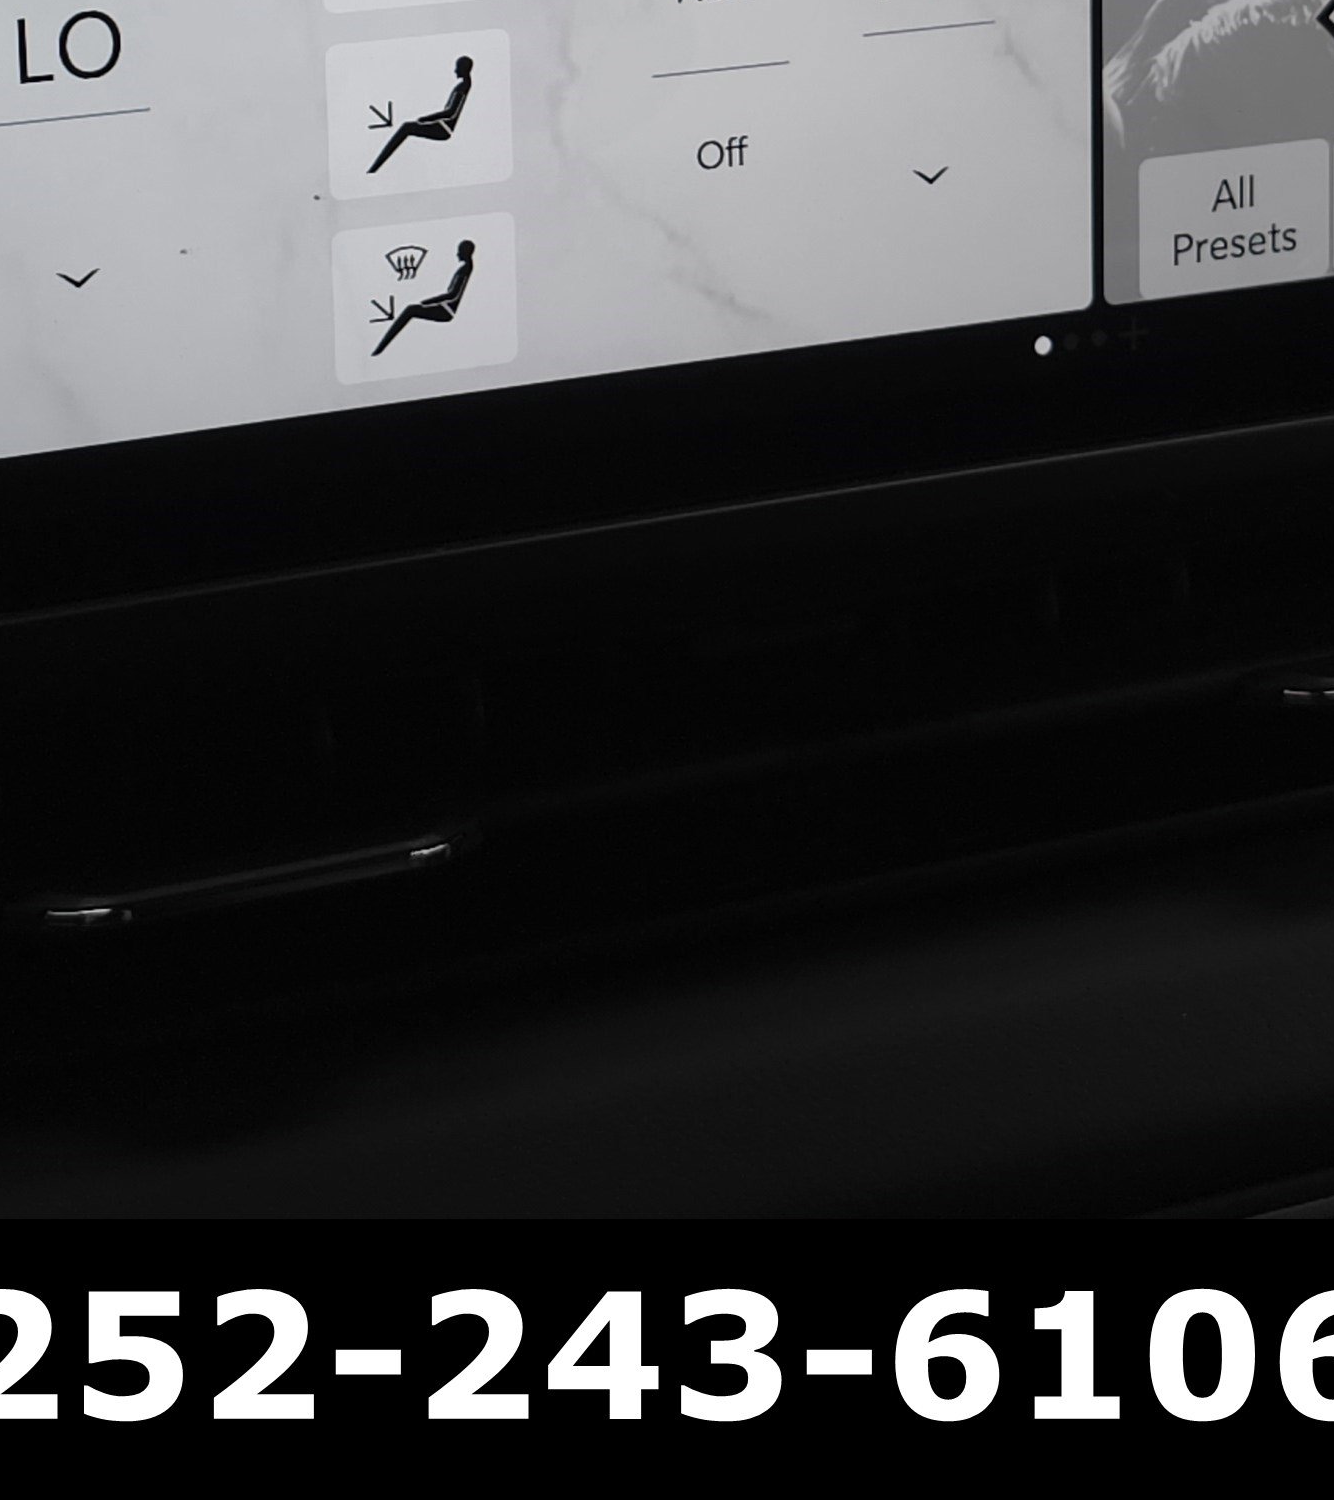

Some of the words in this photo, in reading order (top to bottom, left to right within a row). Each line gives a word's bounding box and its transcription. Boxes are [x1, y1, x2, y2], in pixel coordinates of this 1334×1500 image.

[16, 10, 122, 85] LO
[696, 135, 749, 171] Off
[1211, 174, 1255, 213] All
[1173, 223, 1298, 267] Presets
